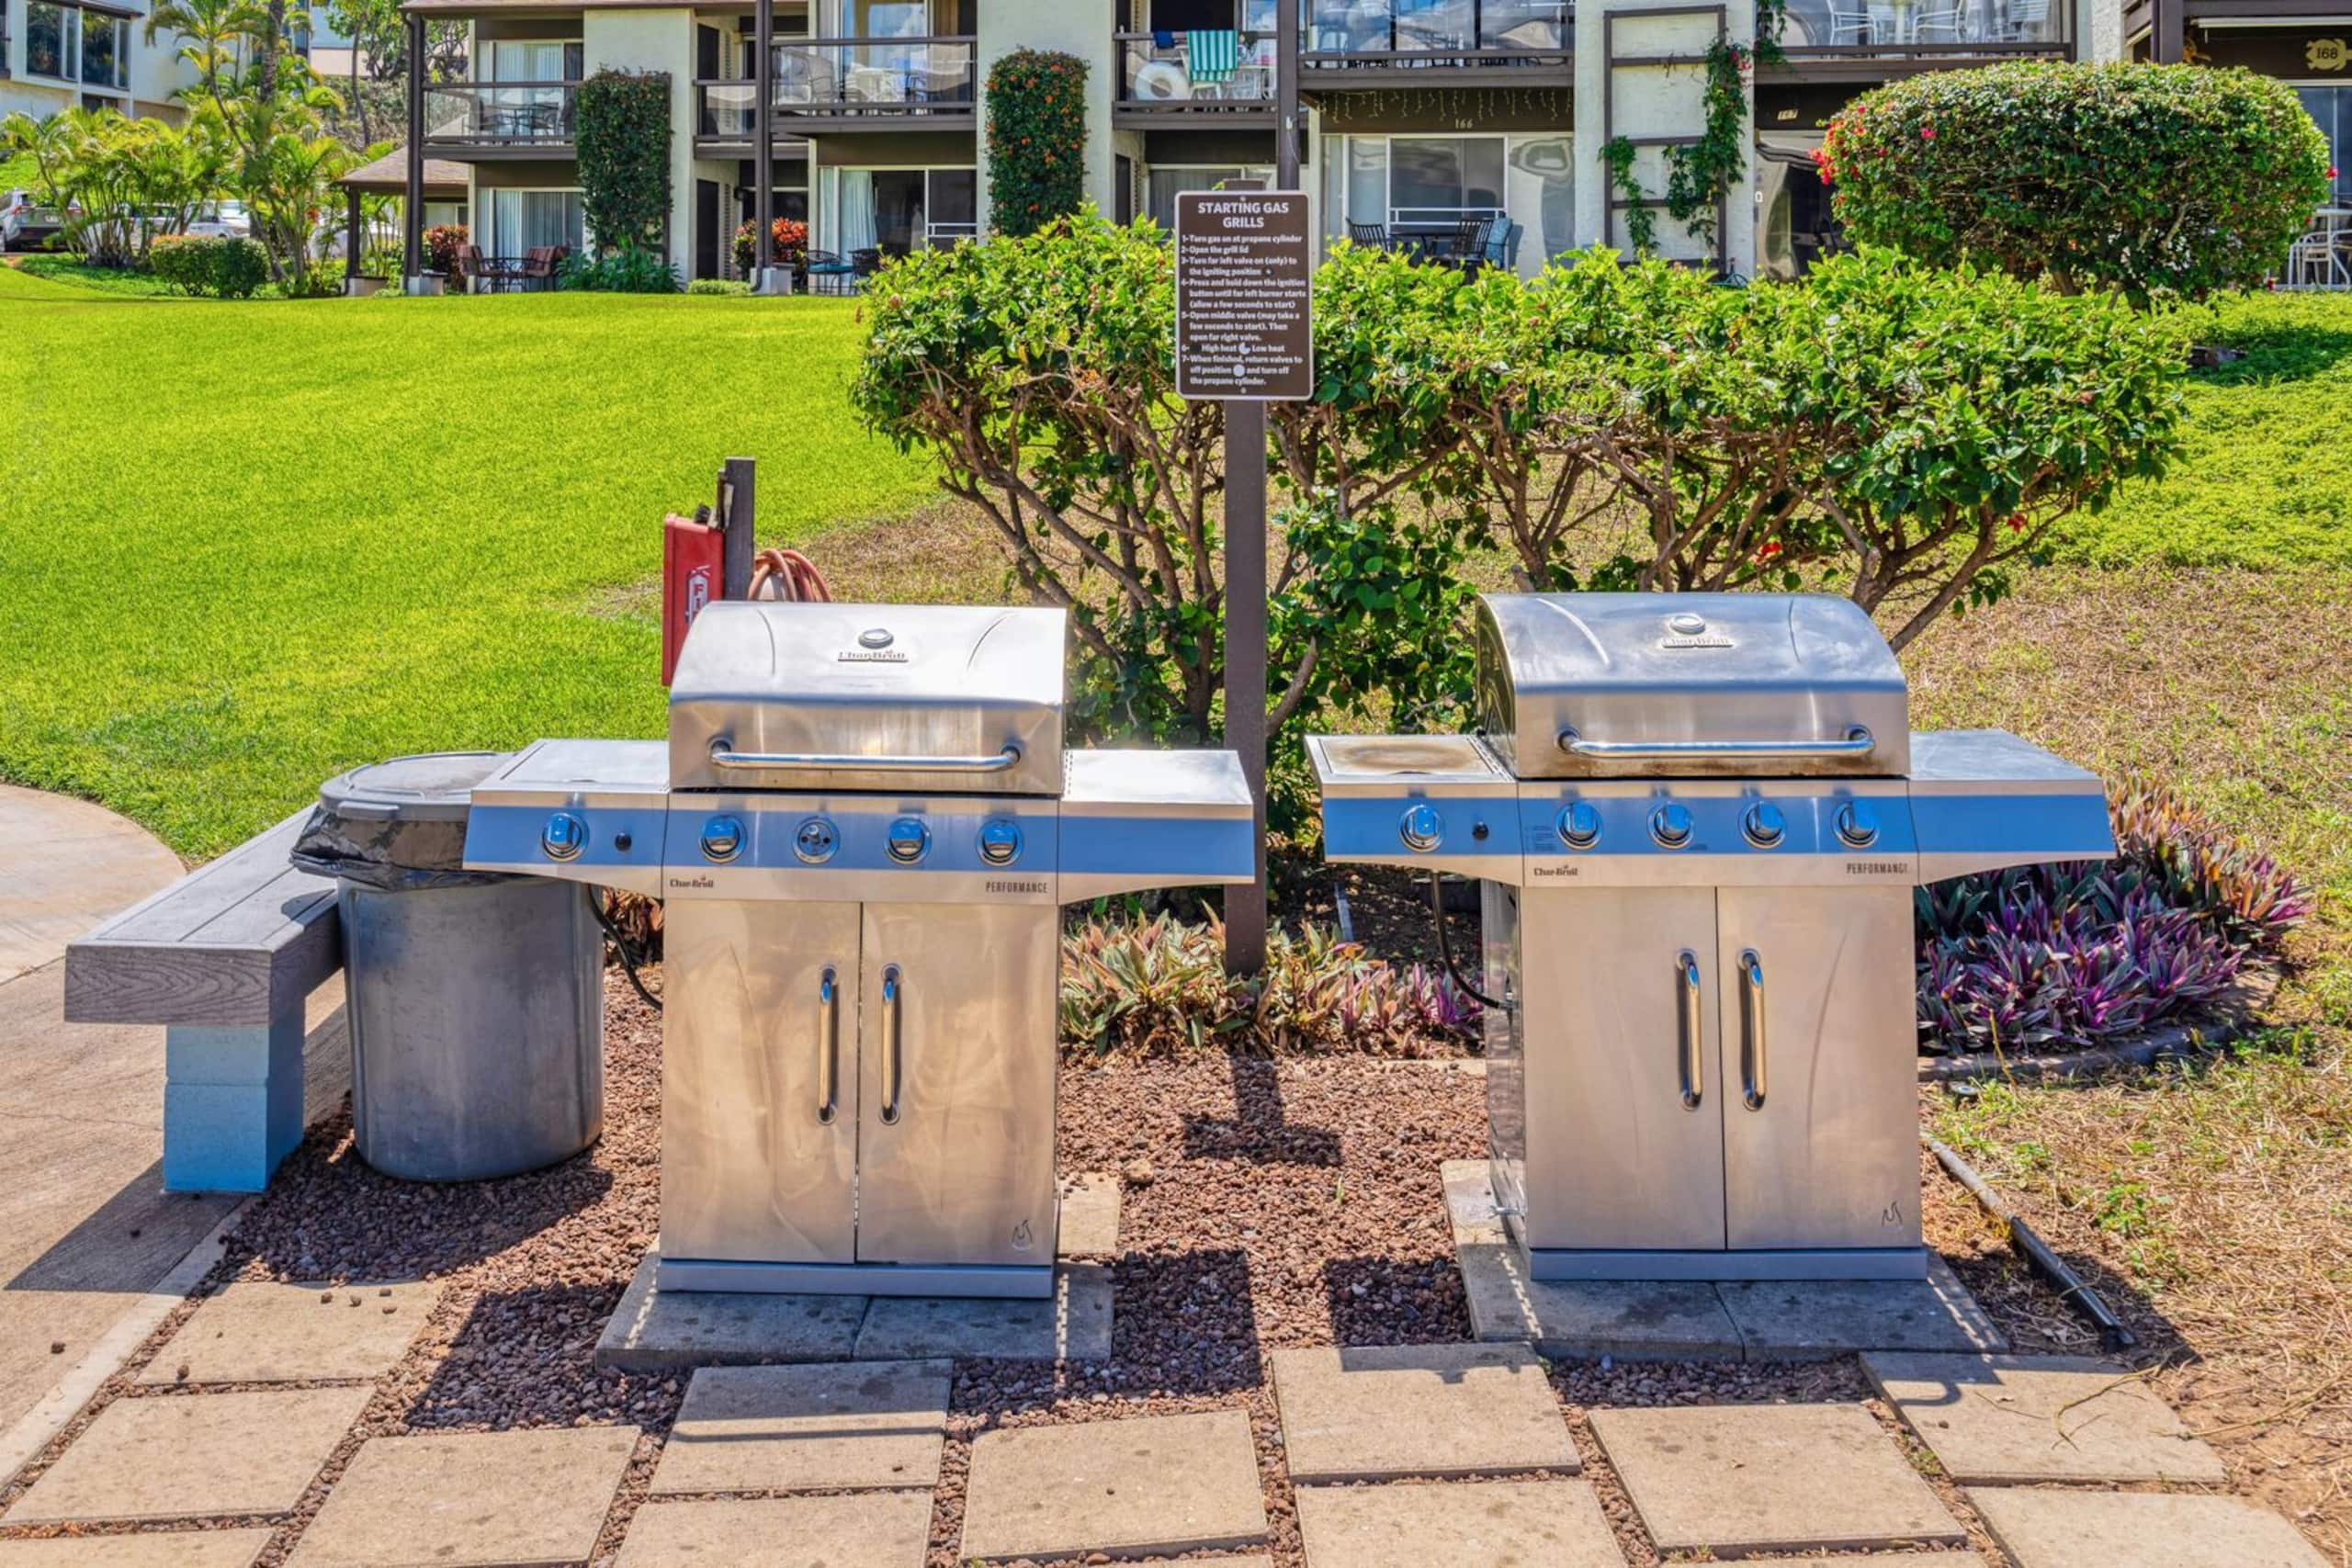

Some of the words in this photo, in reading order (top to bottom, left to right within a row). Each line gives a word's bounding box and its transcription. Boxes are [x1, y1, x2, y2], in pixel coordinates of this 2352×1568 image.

[2315, 47, 2337, 60] 168
[1454, 118, 1474, 130] 166
[1197, 202, 1261, 214] STARTING
[1263, 202, 1289, 214] GAS
[1222, 216, 1265, 228] GRILLS
[1272, 235, 1302, 244] cylinder
[1224, 245, 1238, 254] grill
[1203, 267, 1230, 276] igniting
[1232, 267, 1261, 276] position
[1278, 278, 1306, 288] ignition
[1221, 333, 1238, 343] right
[1202, 344, 1219, 354] High
[1190, 366, 1201, 374] off
[1202, 366, 1231, 375] position
[1247, 366, 1260, 374] and
[1261, 366, 1277, 374] turn
[1279, 366, 1289, 374] off
[986, 881, 1050, 894] PERFORMANCE
